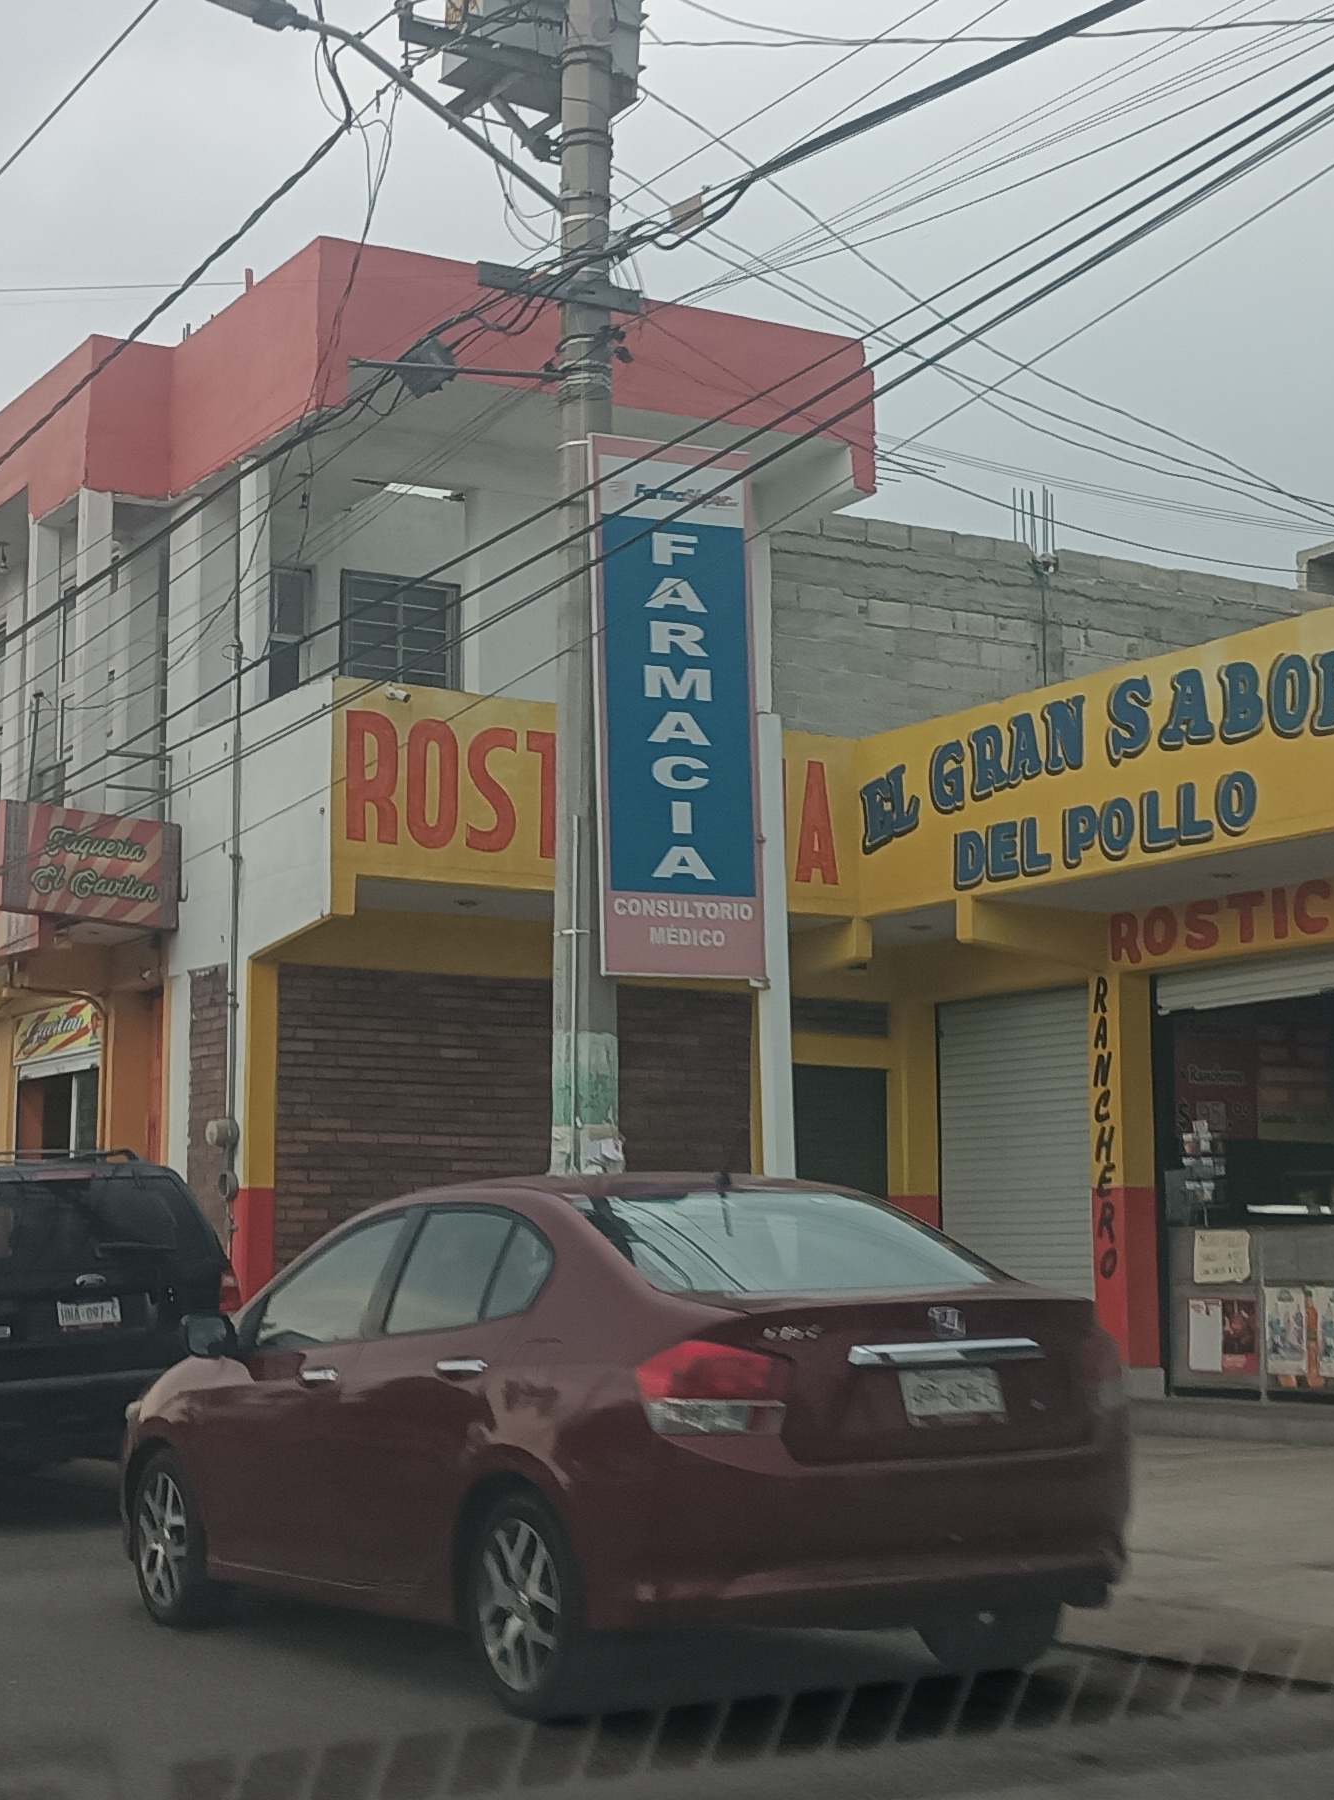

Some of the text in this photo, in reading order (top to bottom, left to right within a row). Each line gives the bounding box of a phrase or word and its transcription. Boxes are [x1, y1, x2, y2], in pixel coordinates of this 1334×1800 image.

[643, 532, 716, 882] FARMACIA
[861, 765, 920, 855] EL
[929, 694, 1087, 815] GRAN
[30, 864, 66, 895] El
[954, 770, 1259, 892] DEL POLLO
[613, 897, 754, 922] CONSULTORIO
[1092, 976, 1118, 1280] RANCHERO
